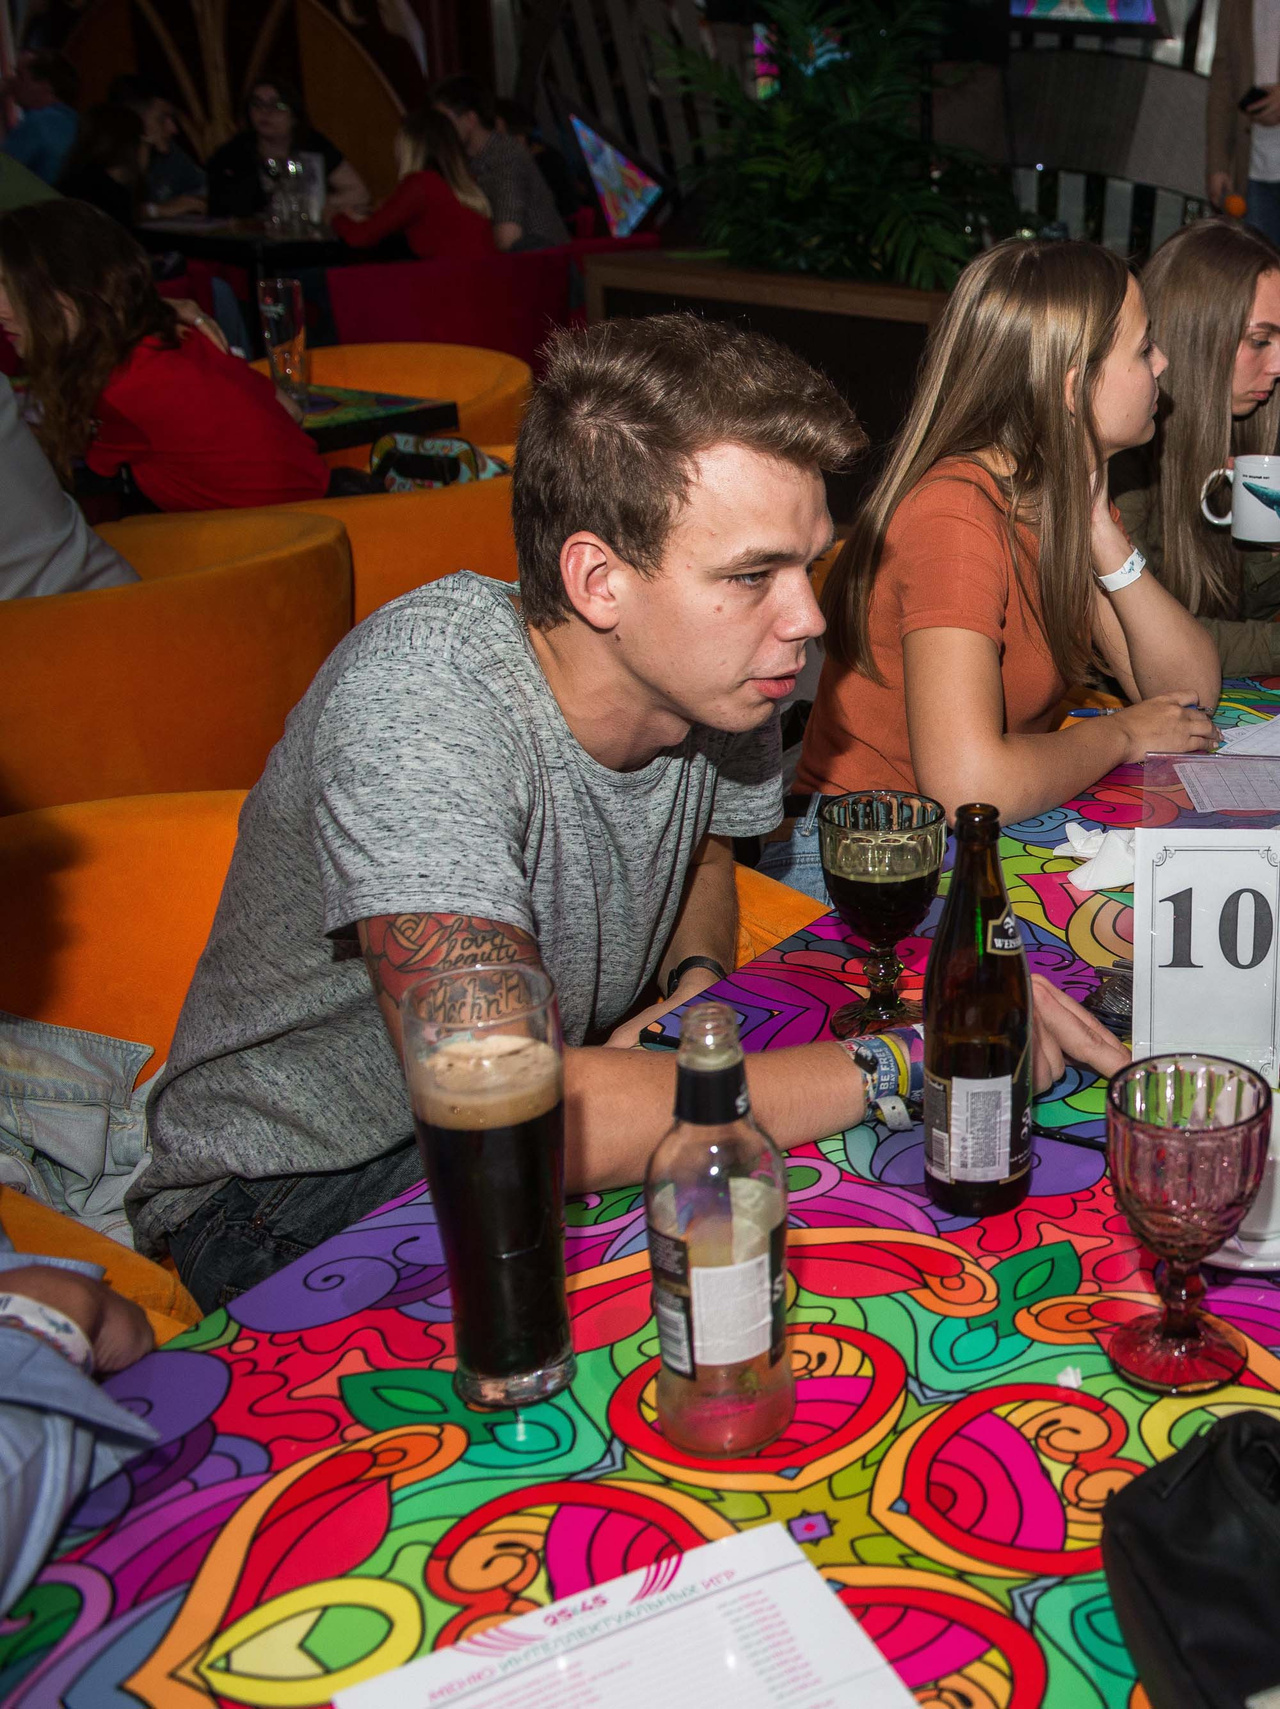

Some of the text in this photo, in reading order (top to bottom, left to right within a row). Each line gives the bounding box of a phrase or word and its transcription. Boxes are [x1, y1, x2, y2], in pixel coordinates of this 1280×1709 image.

[1158, 887, 1274, 969] 10
[873, 1047, 889, 1090] BE FREE
[701, 1568, 737, 1591] ИГР
